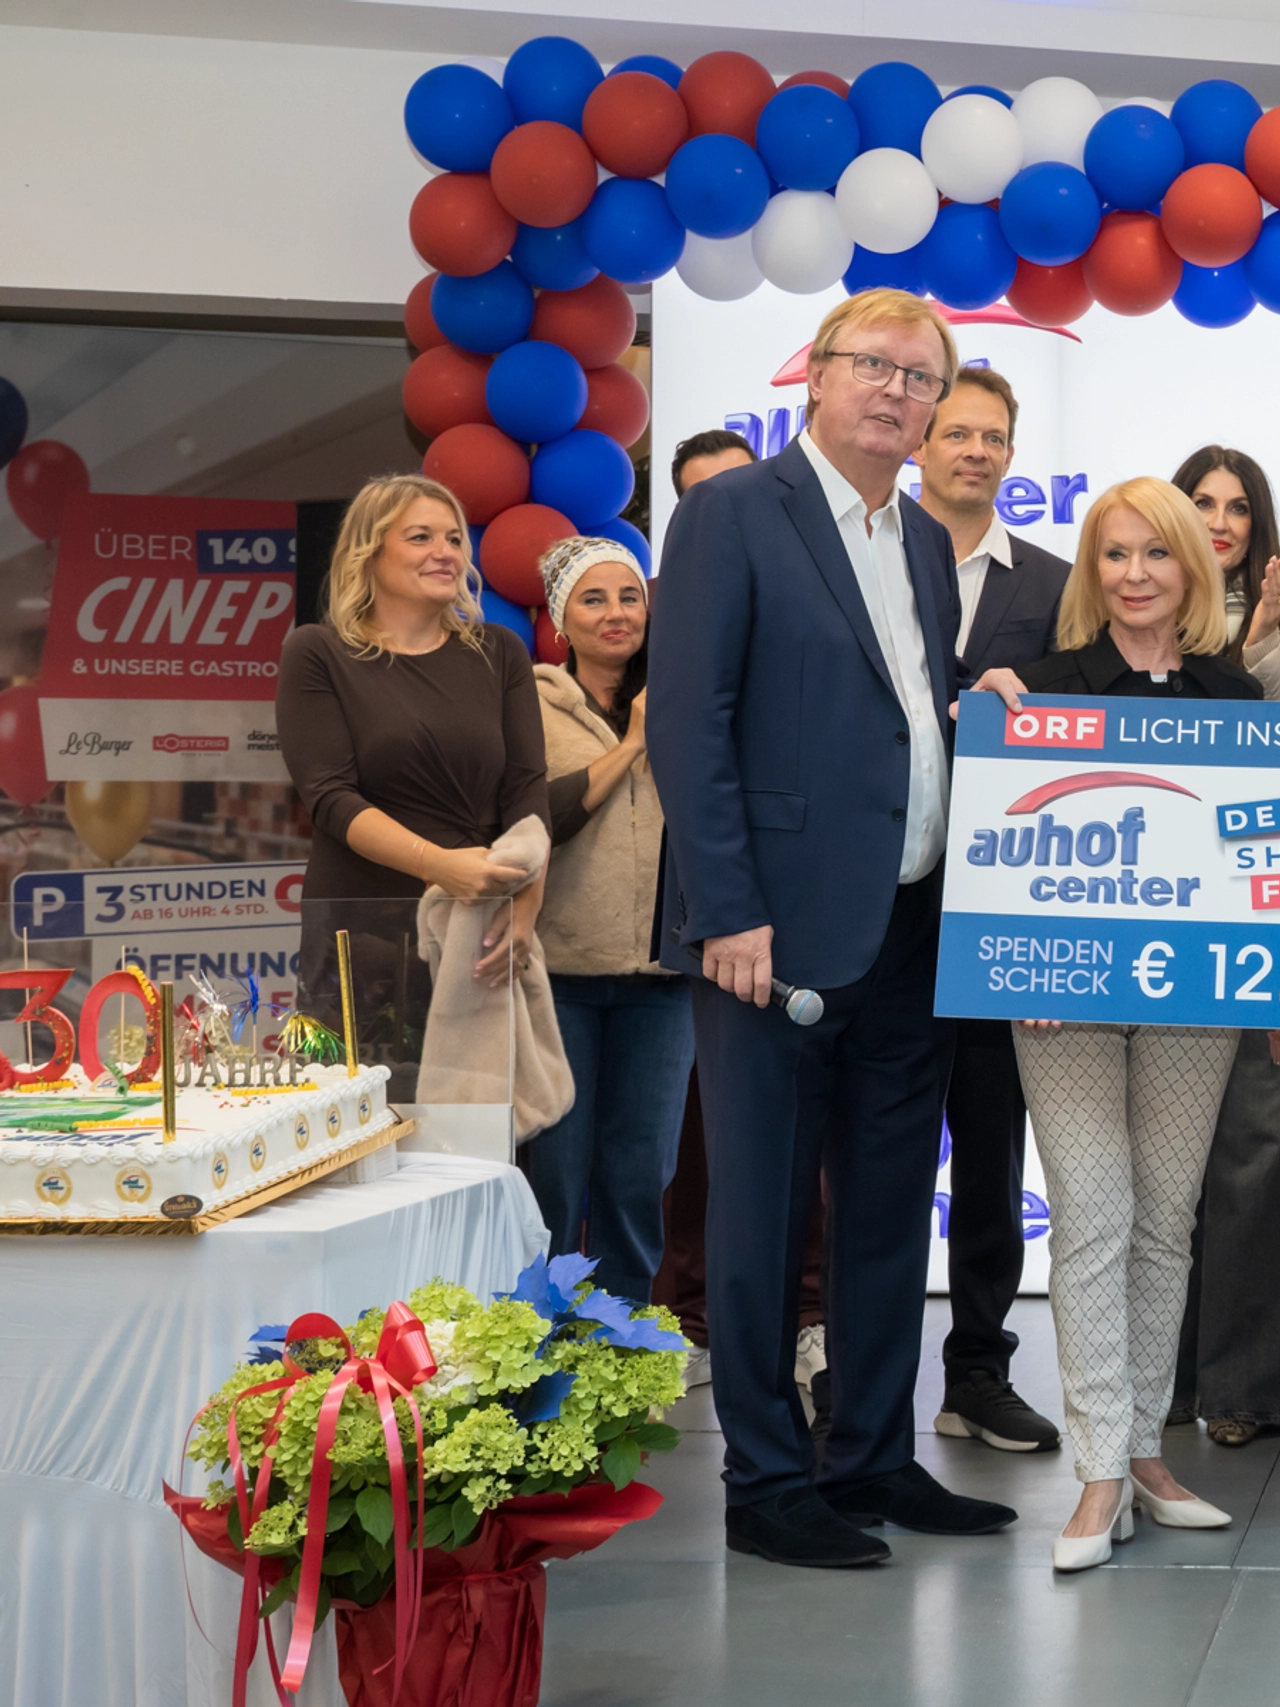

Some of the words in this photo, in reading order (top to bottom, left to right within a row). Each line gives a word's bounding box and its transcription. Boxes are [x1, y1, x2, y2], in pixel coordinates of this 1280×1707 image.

[94, 527, 193, 561] ÜBER
[207, 536, 278, 565] 140
[76, 576, 297, 646] CINEP
[72, 658, 88, 674] &
[94, 658, 185, 676] UNSERE
[83, 731, 134, 757] Burger
[1011, 713, 1099, 740] ORF
[1119, 716, 1224, 746] LICHT
[966, 806, 1146, 867] auhof
[32, 887, 66, 926] P
[94, 885, 125, 923] 3
[128, 879, 266, 903] STUNDEN
[1029, 868, 1201, 907] center
[130, 909, 153, 920] AB
[159, 907, 173, 919] 16
[178, 906, 216, 919] UHR:
[221, 904, 230, 916] 4
[235, 903, 268, 915] STD.
[978, 935, 1114, 965] SPENDEN
[988, 966, 1110, 997] SCHECK
[1131, 941, 1175, 999] €
[174, 1051, 312, 1088] JAHRE
